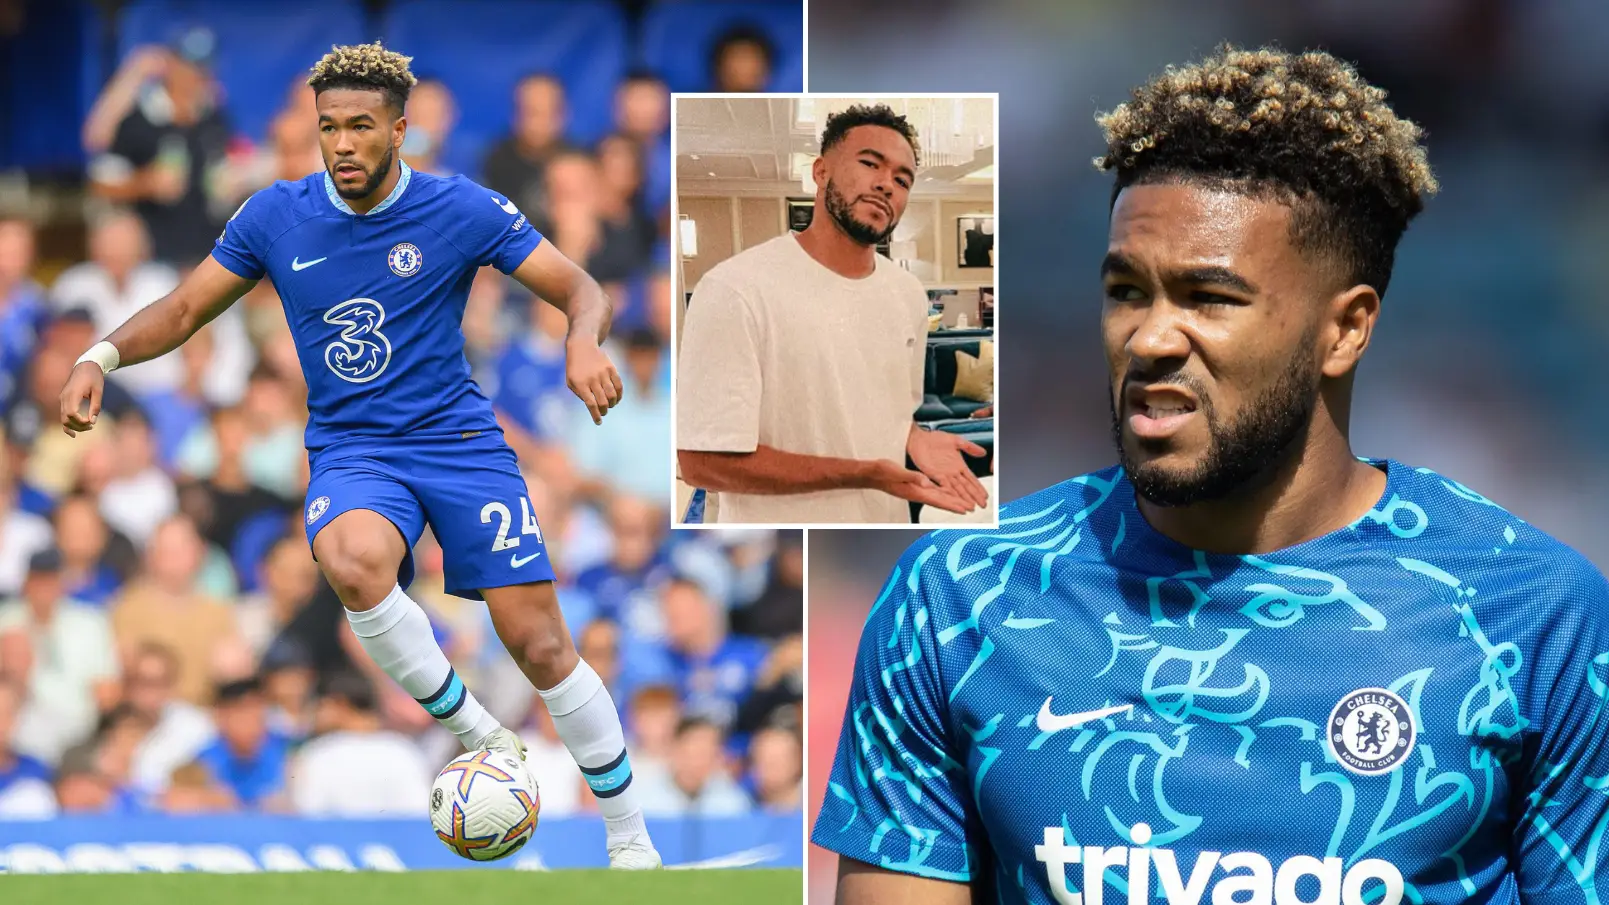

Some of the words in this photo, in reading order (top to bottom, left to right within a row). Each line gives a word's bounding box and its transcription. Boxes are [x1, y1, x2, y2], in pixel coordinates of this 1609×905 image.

[480, 496, 543, 552] 24
[431, 694, 455, 713] CFC
[1347, 694, 1399, 714] CHELSEA
[1341, 751, 1376, 769] FOOTBALL
[1377, 754, 1396, 768] CLUB
[590, 776, 616, 788] CFC
[1034, 822, 1405, 905] trivago
